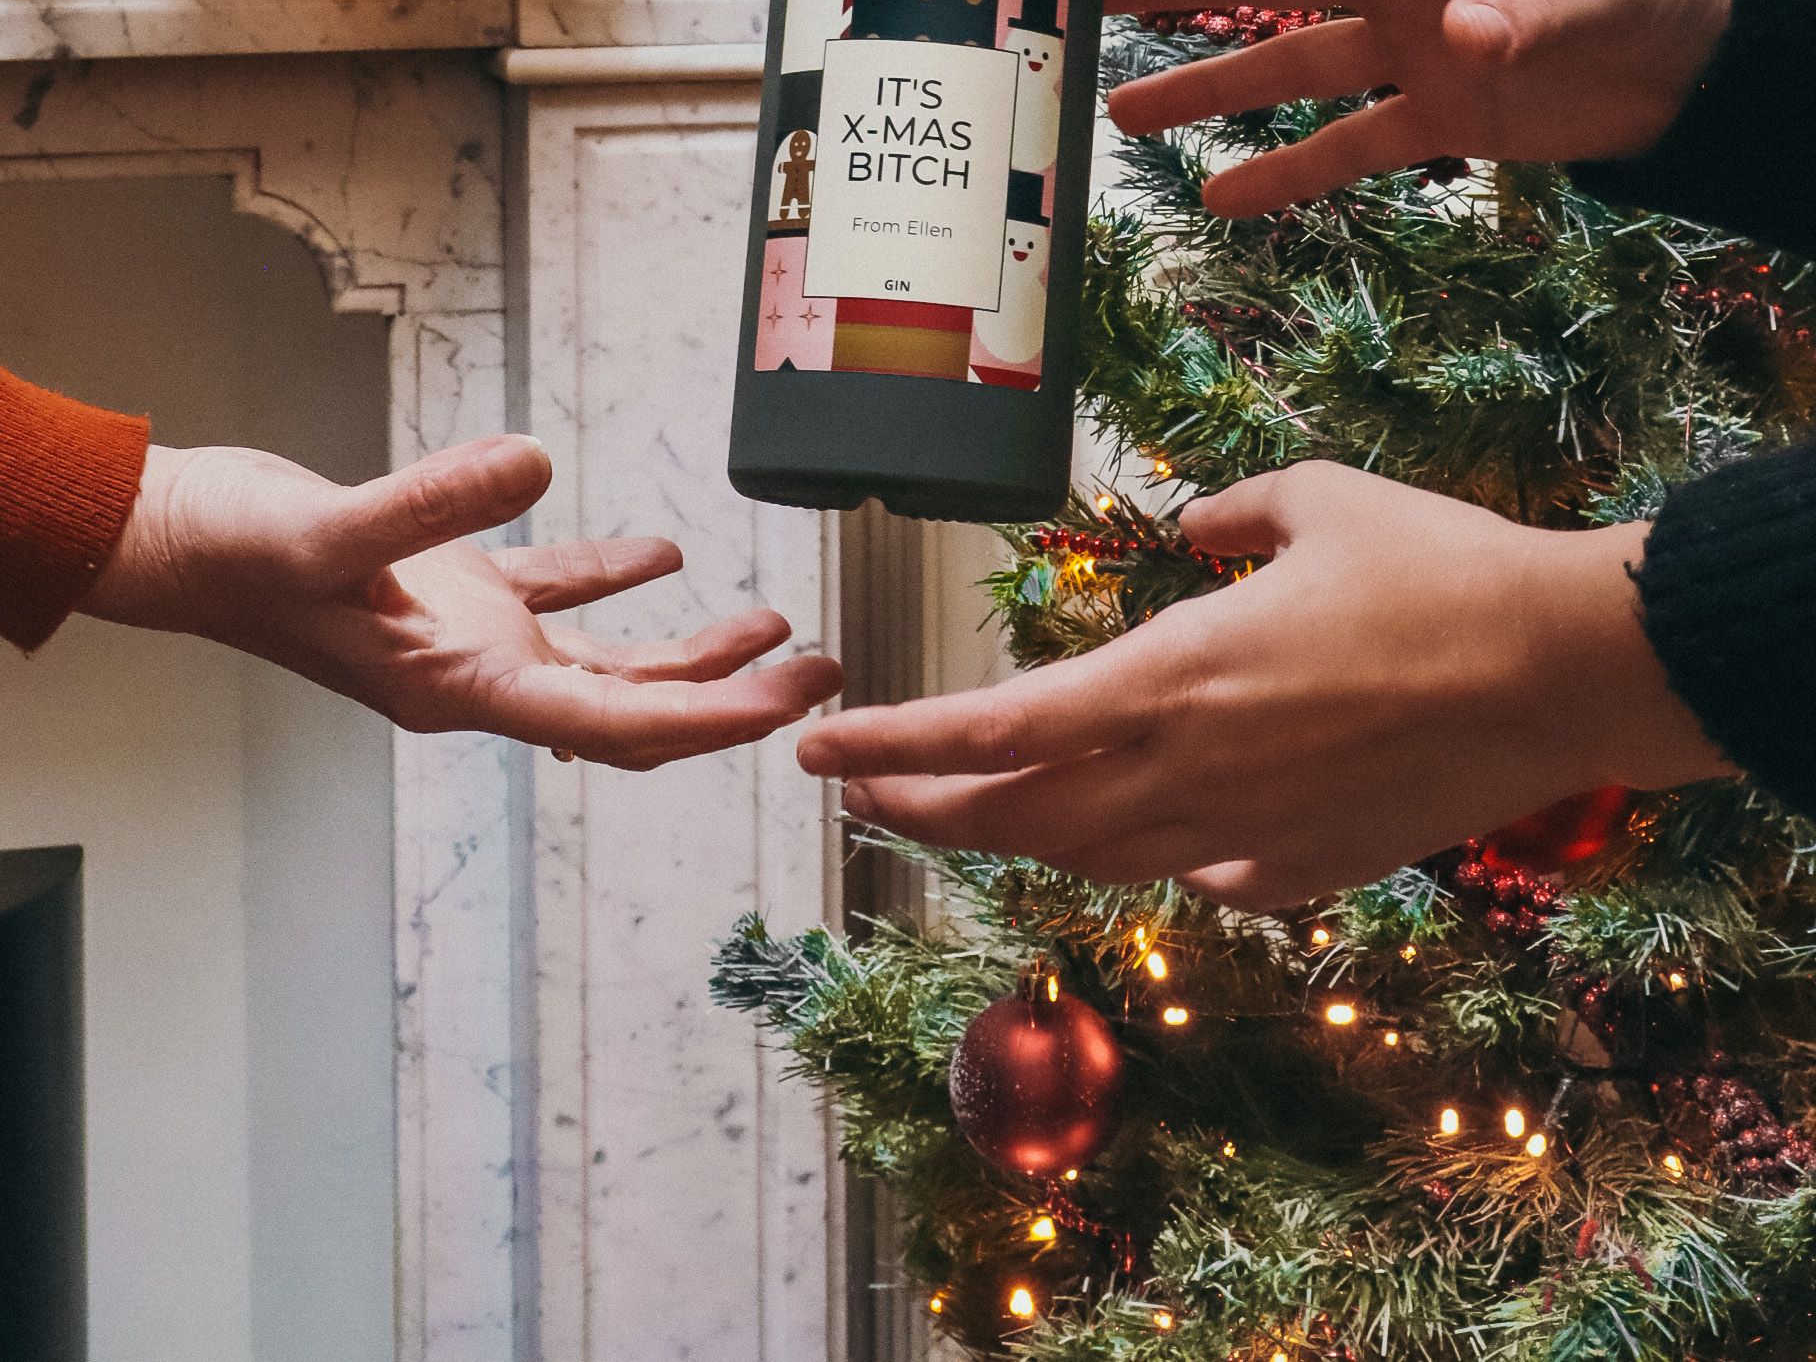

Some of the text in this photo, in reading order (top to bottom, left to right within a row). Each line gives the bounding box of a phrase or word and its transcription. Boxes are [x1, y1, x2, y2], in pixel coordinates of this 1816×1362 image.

[876, 77, 943, 110] IT'S
[841, 114, 973, 151] X-MAS
[848, 152, 970, 190] BITCH
[852, 217, 953, 239] From Ellen
[884, 279, 911, 293] GIN
